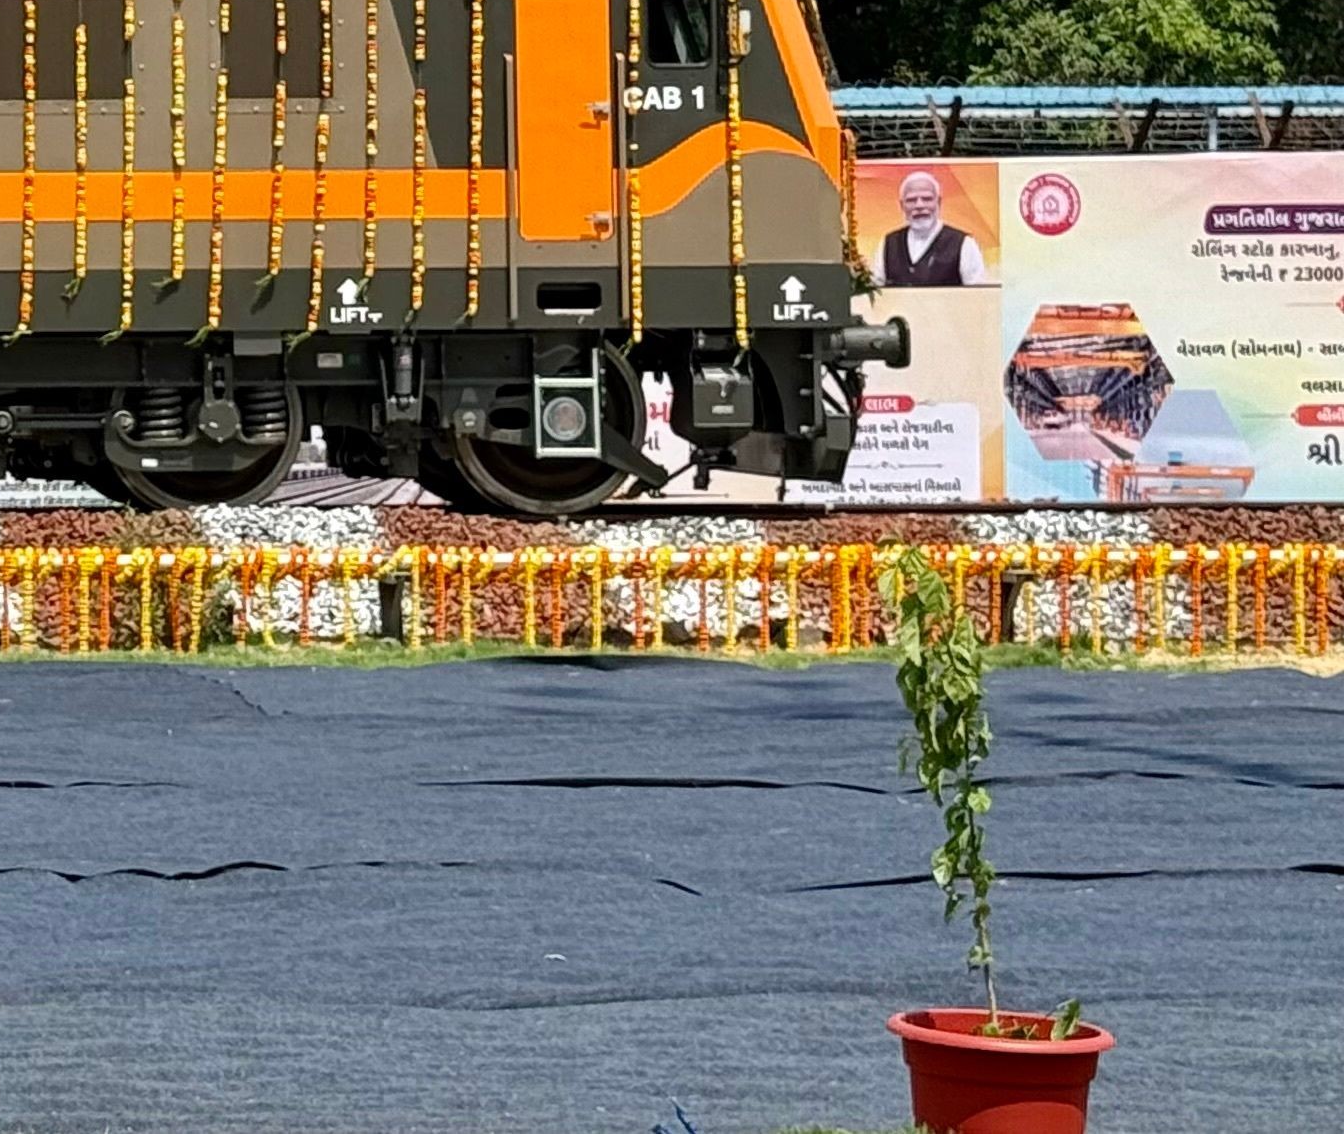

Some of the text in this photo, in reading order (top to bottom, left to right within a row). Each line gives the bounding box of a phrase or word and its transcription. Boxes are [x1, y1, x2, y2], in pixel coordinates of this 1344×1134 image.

[623, 85, 704, 110] CAB 1
[1212, 208, 1344, 231] પ્રગતિશીલ ગુજરા
[330, 307, 369, 323] LIFT
[773, 304, 815, 321] LIFT
[1176, 339, 1226, 356] વેરાવળ
[1307, 434, 1343, 466] શ્રી
